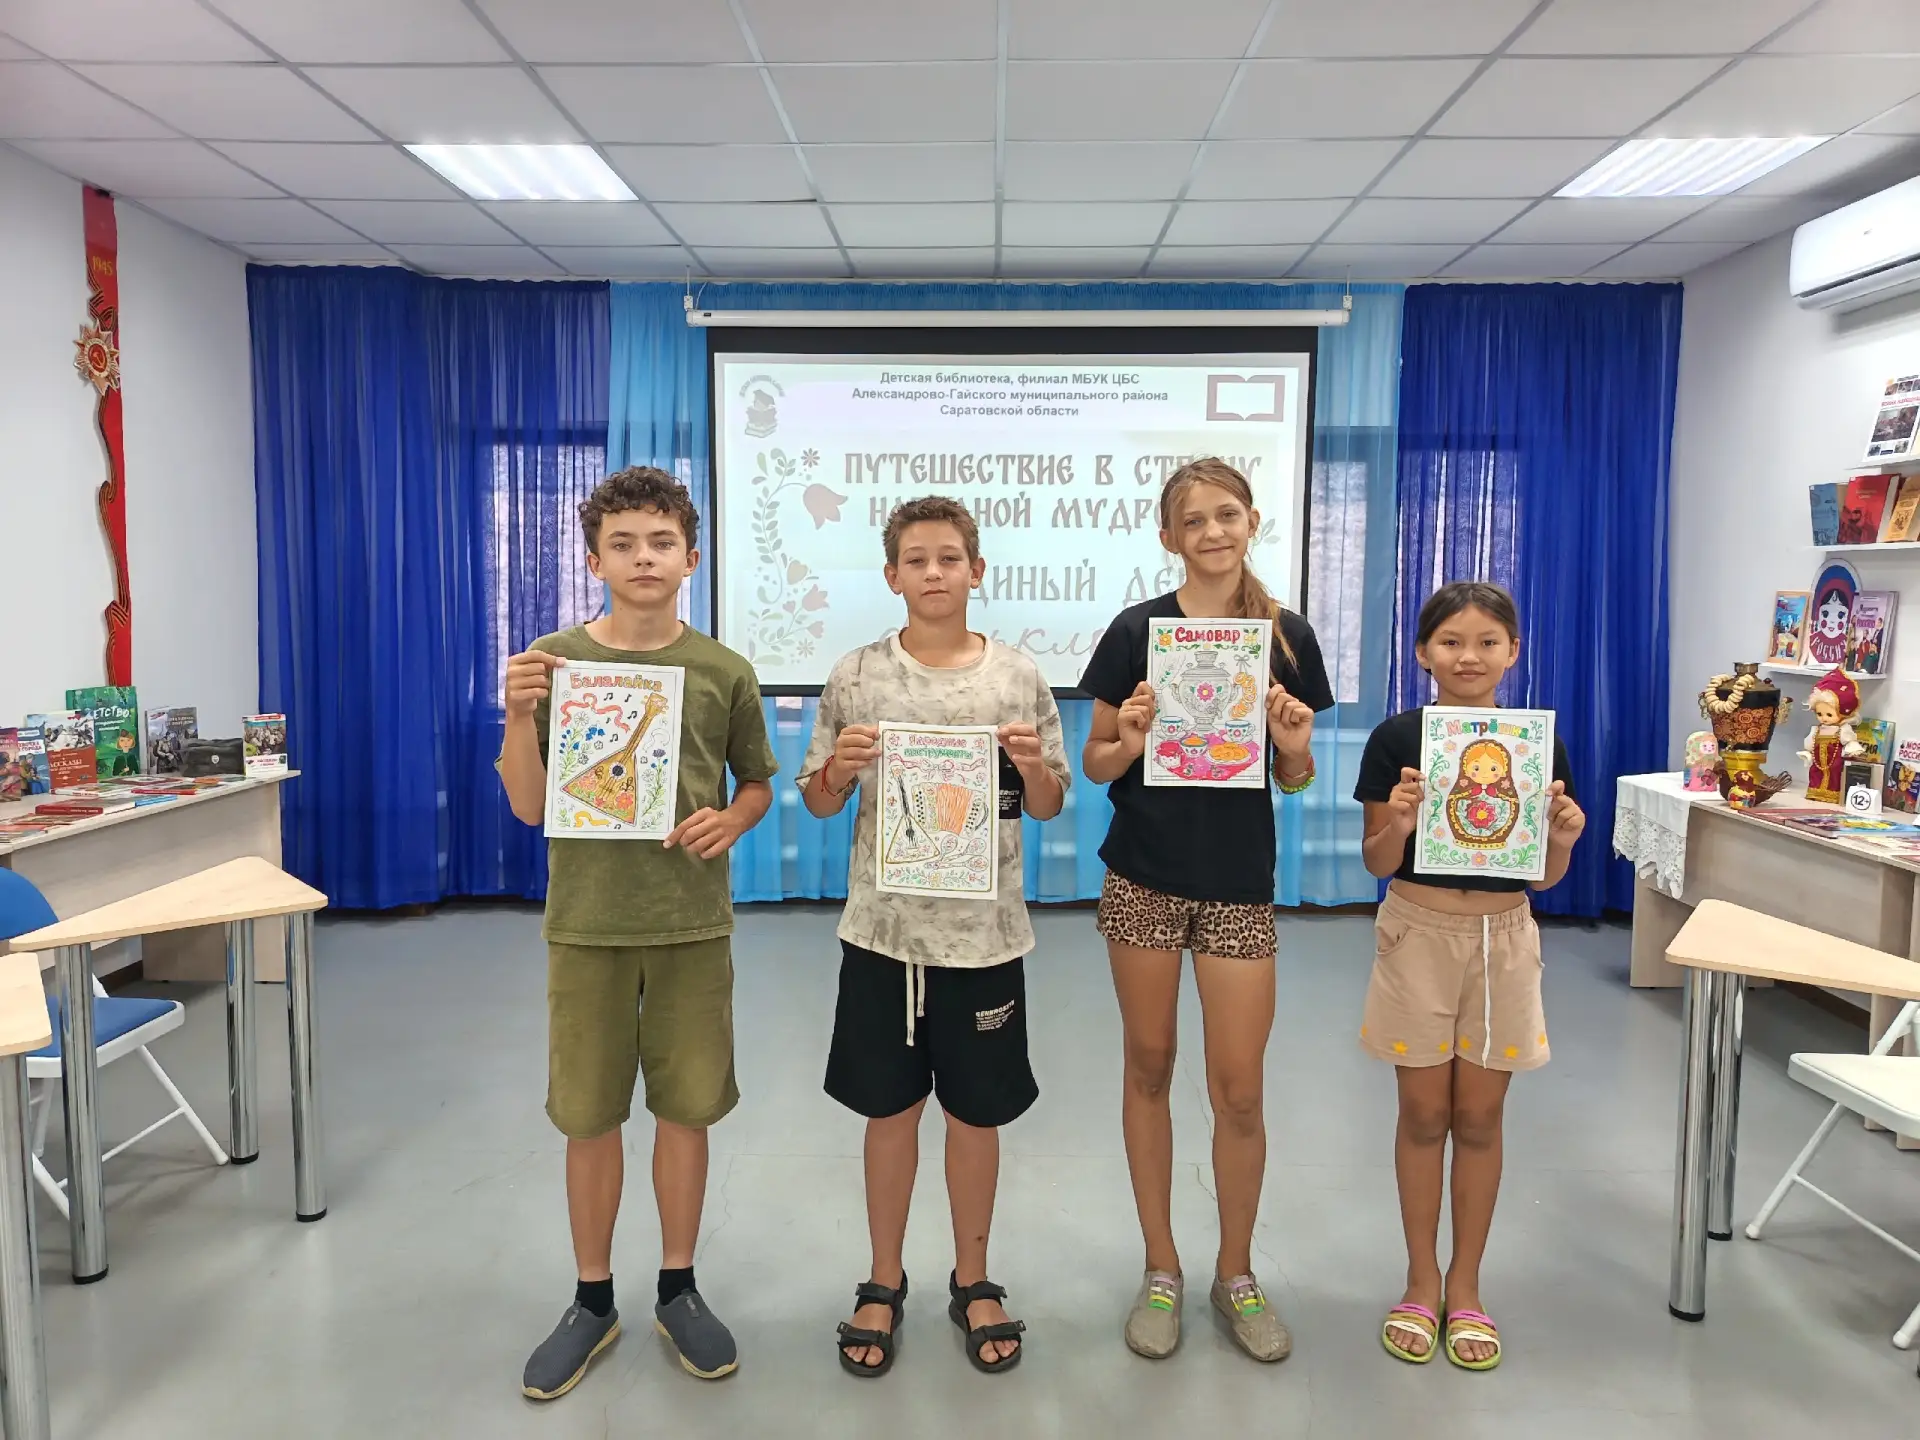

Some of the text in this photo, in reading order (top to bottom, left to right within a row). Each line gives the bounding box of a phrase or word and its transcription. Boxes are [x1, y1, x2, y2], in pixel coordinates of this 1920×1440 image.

[880, 372, 1140, 386] Детская библиотека, филиал МБУК ЦБС
[852, 388, 1168, 402] Александрово-Гайского муниципального района
[940, 405, 1079, 417] Саратовской области
[845, 453, 1074, 485] ПУТЕШЕСТВИЕ
[1094, 454, 1113, 485] В
[1051, 497, 1162, 535] МУДР
[968, 557, 1186, 608] ДИНЫЙ ДЕ
[1174, 626, 1241, 644] Самовар
[569, 672, 663, 692] Балалайка
[1445, 718, 1529, 740] Матрёшка
[1853, 794, 1869, 806] 12+
